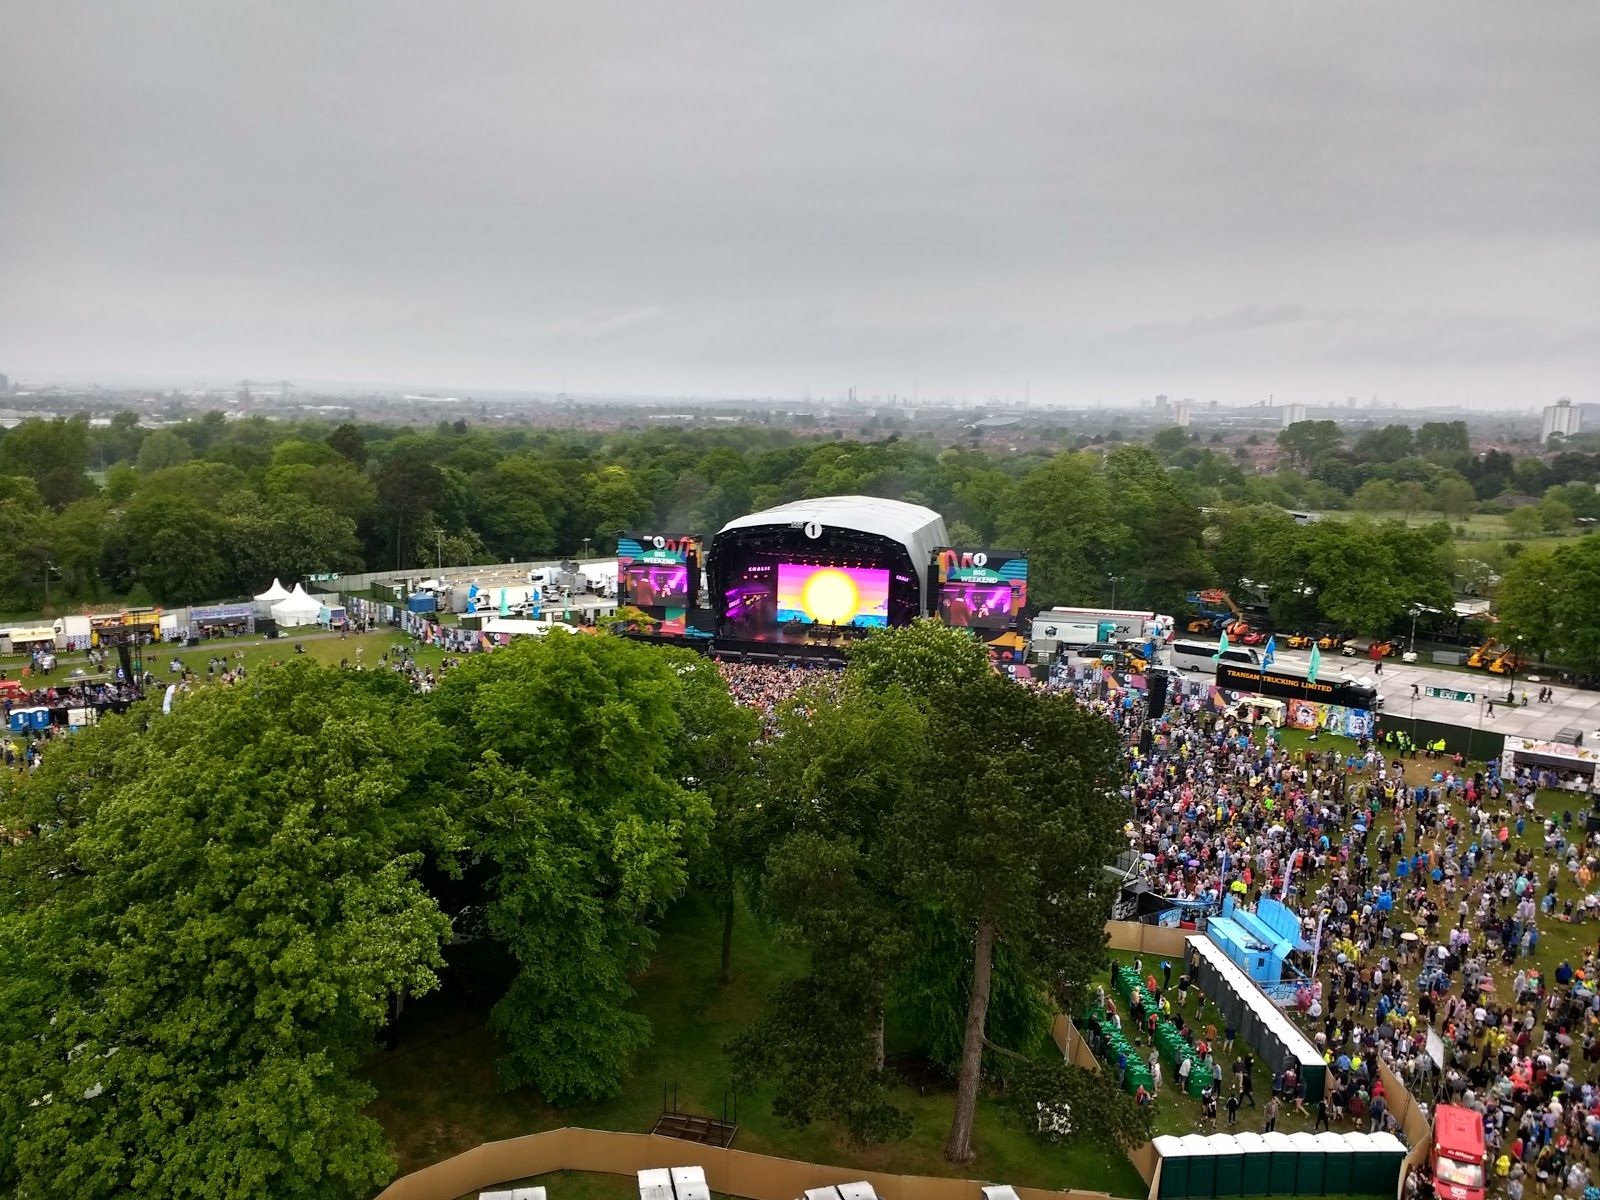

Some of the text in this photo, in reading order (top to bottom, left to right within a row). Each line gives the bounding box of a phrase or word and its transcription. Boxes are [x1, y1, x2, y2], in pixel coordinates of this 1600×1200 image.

[643, 557, 676, 565] WEEKEND
[960, 575, 998, 584] WEEKEND
[1226, 669, 1333, 692] TRANSAM TRUCKING LIMITED
[1439, 690, 1474, 703] EXIT A
